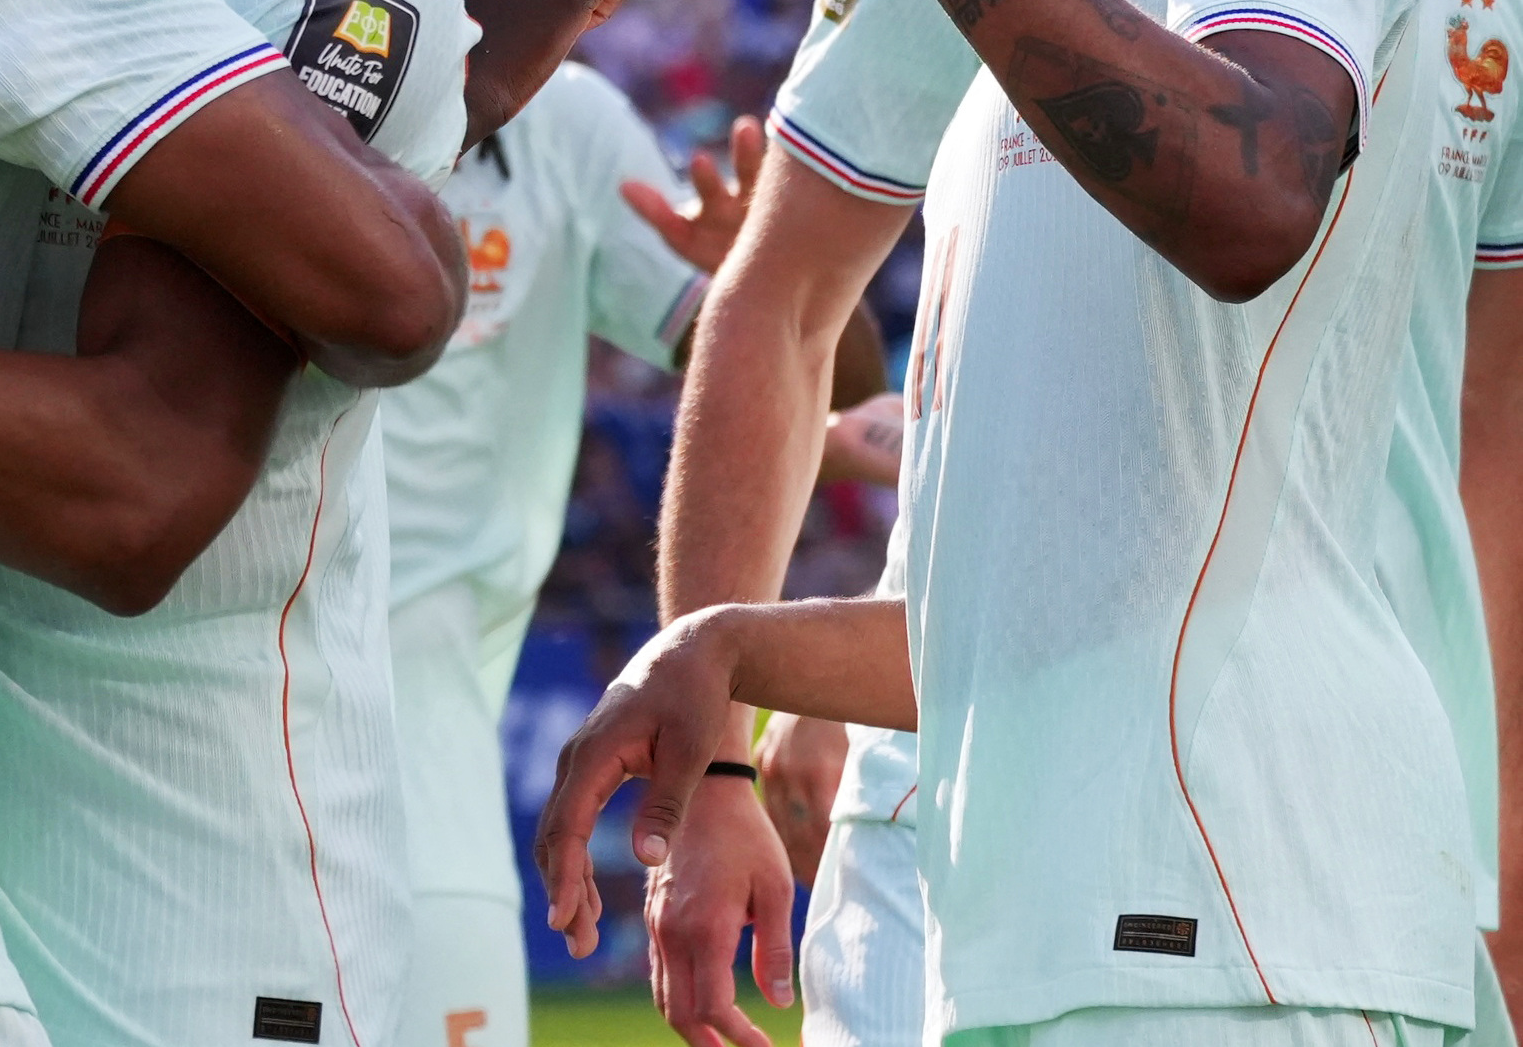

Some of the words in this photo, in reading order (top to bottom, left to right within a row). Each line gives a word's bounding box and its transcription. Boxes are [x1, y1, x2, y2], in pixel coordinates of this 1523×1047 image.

[318, 43, 363, 75] Unite
[361, 60, 383, 85] For
[298, 65, 382, 120] EDUCATION
[1001, 132, 1024, 151] FRANCE
[998, 155, 1009, 171] 09
[1012, 149, 1036, 167] JUILLET
